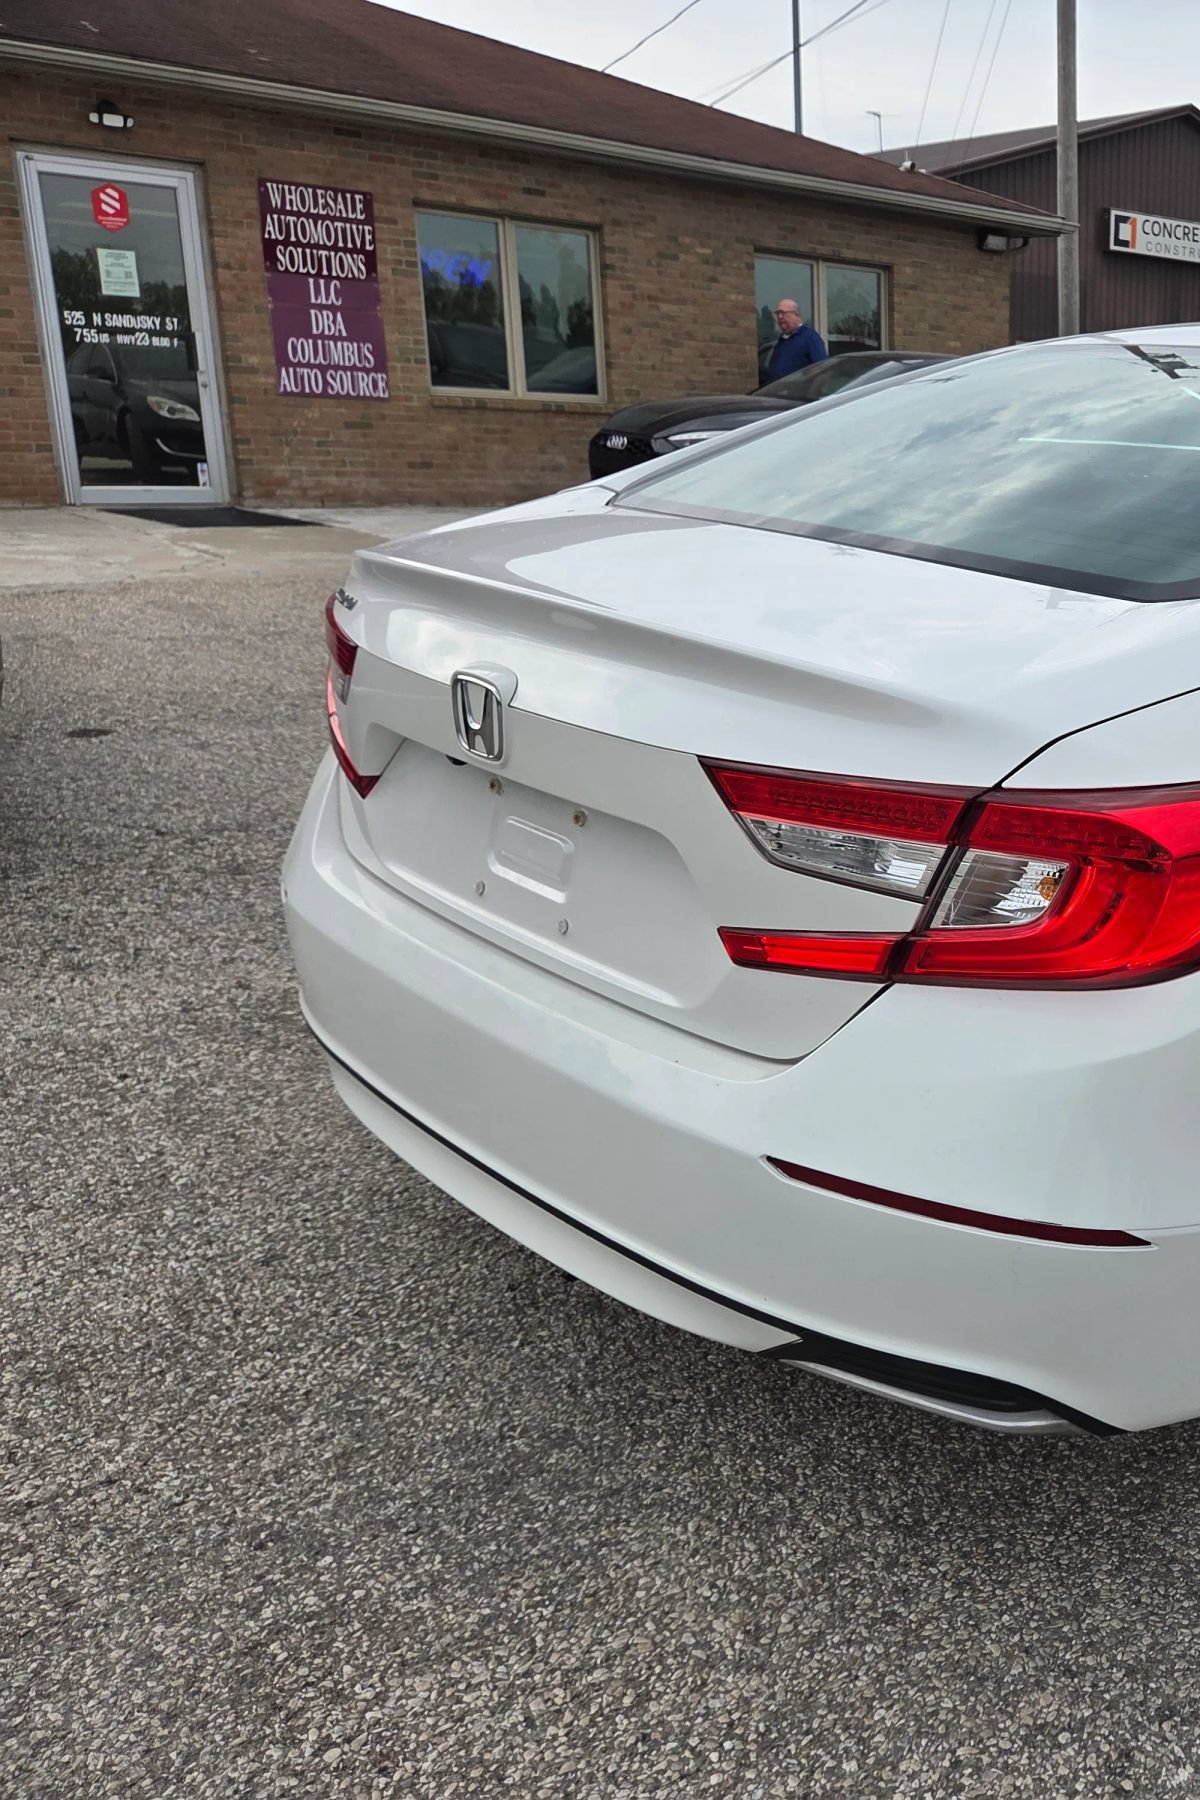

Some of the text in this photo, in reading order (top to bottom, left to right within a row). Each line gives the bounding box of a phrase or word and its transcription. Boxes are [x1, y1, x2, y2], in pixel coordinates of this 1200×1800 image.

[266, 182, 365, 220] WHOLESALE
[264, 213, 375, 251] AUTOMOTIVE
[276, 245, 367, 280] SOLUTIONS
[308, 277, 342, 306] LLC
[63, 310, 178, 331] 525 N SANDUSKY ST
[310, 309, 347, 337] DBA
[287, 337, 375, 369] COLUMBUS
[280, 366, 389, 398] AUTO SOURCE
